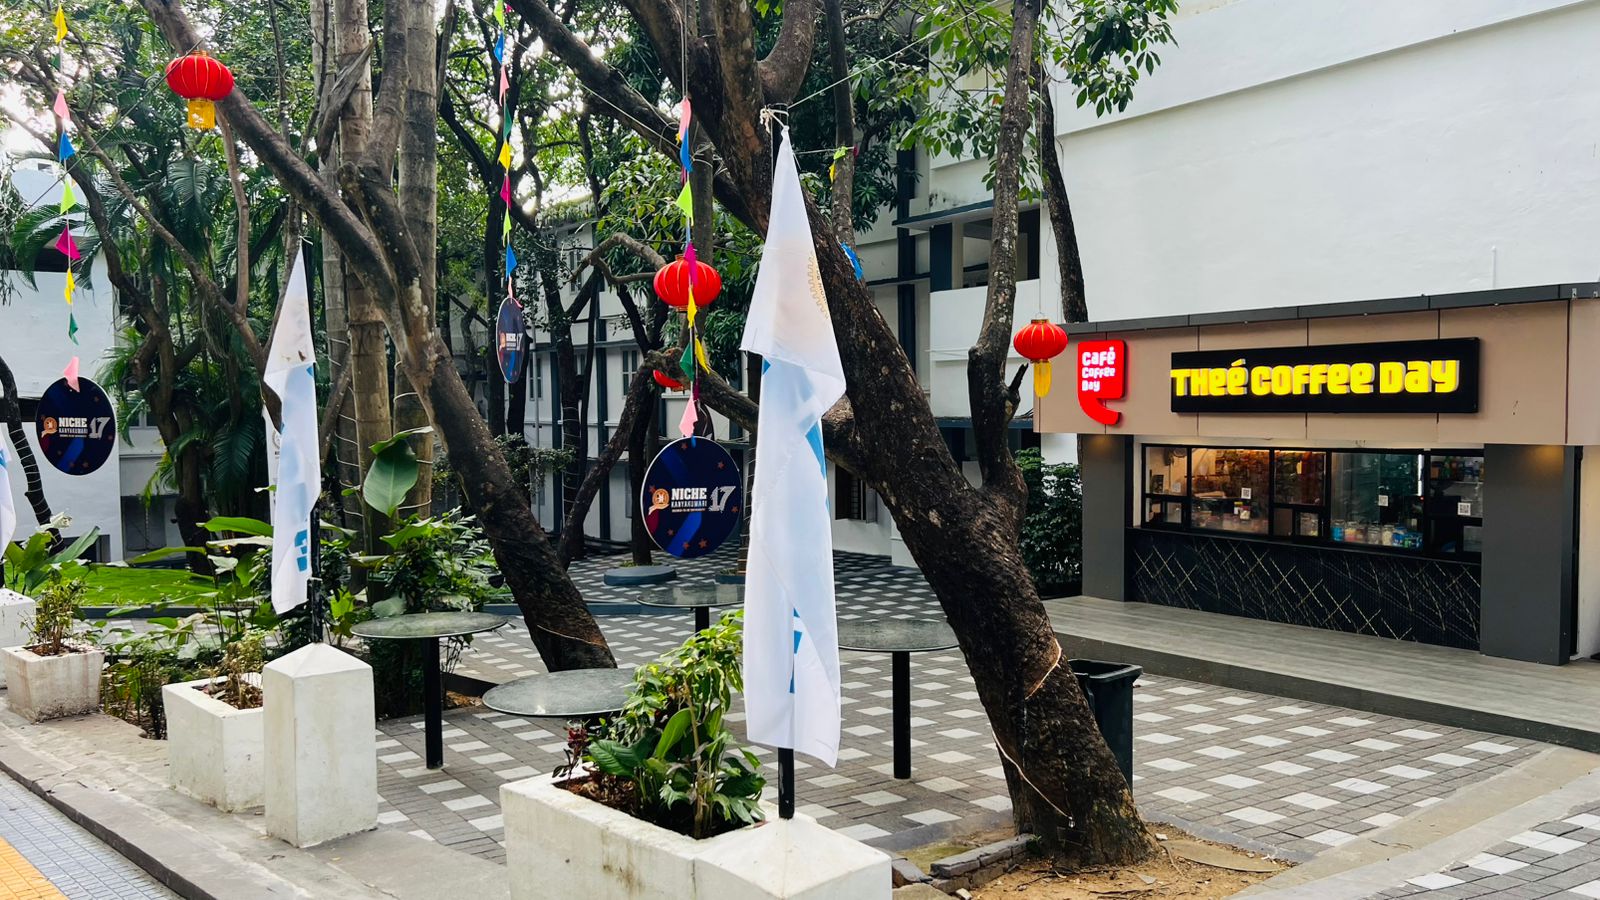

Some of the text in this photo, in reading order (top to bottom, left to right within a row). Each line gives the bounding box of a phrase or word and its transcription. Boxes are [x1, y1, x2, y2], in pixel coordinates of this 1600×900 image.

[58, 417, 111, 440] NICHE 17
[671, 486, 736, 513] NICHE 17
